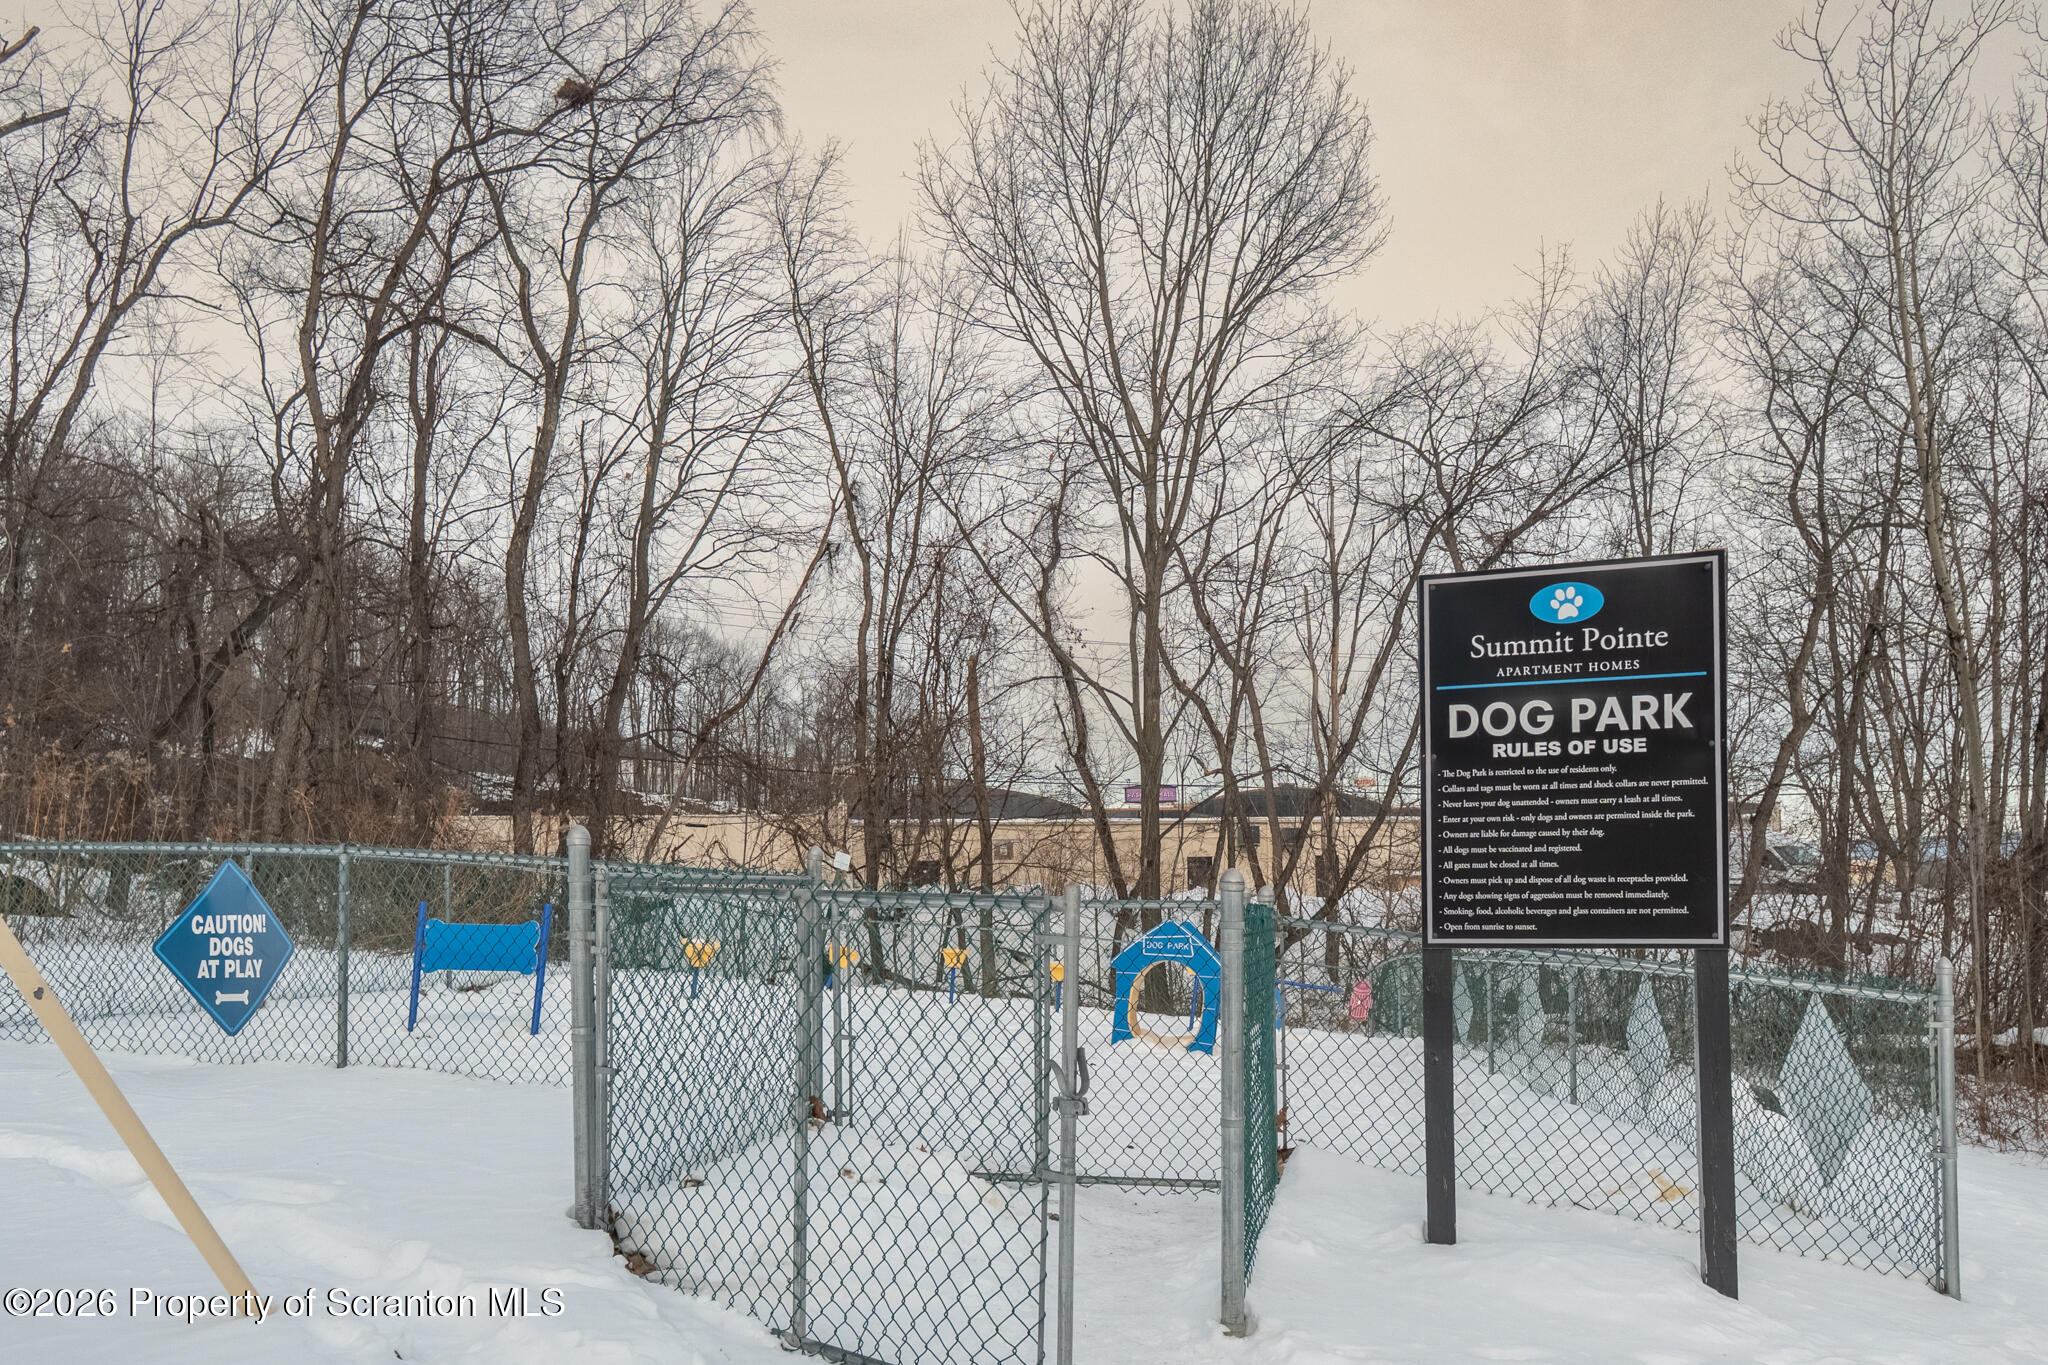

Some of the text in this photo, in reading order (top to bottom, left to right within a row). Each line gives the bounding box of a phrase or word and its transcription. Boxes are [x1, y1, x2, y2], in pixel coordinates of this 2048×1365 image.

[1470, 626, 1669, 659] Summit Pointe
[1496, 659, 1640, 678] APARTMENT HOMES
[1448, 692, 1694, 739] DOG PARK
[1492, 737, 1647, 758] RULES OF USE
[1441, 769, 1455, 777] The
[1456, 769, 1471, 779] Dog
[1472, 768, 1487, 776] Park
[1488, 768, 1494, 776] is
[1494, 766, 1525, 775] restricted
[1535, 766, 1547, 774] the
[1560, 764, 1569, 773] of
[1569, 764, 1599, 773] residents
[1599, 763, 1617, 774] only.
[1441, 784, 1465, 793] Collars
[1466, 783, 1479, 792] and
[1480, 785, 1494, 793] tags
[1512, 782, 1521, 791] be
[1549, 780, 1558, 789] all
[1559, 781, 1578, 789] times
[1578, 779, 1592, 789] and
[1593, 779, 1614, 788] shock
[1614, 778, 1637, 787] collars
[1671, 775, 1708, 788] permitted.
[1442, 799, 1462, 808] Never
[1462, 799, 1479, 807] leave
[1480, 800, 1496, 809] your
[1496, 798, 1510, 808] dog
[1511, 796, 1549, 806] unattended
[1598, 797, 1617, 805] carry
[1623, 794, 1641, 803] leash
[1650, 793, 1660, 802] all
[1661, 793, 1683, 802] times.
[1442, 815, 1461, 823] Enter
[1469, 816, 1485, 824] your
[1502, 813, 1515, 821] risk
[1520, 812, 1536, 823] only
[1536, 812, 1553, 823] dogs
[1554, 811, 1567, 820] and
[1605, 810, 1640, 821] permitted
[1641, 809, 1662, 818] inside
[1663, 809, 1675, 818] the
[1676, 808, 1695, 820] park.
[1442, 830, 1468, 838] Owners
[1480, 829, 1498, 837] liable
[1499, 828, 1510, 837] for
[1510, 828, 1537, 839] damage
[1537, 827, 1560, 836] caused
[1561, 827, 1570, 838] by
[1571, 827, 1588, 836] their
[1589, 827, 1605, 837] dog.
[1442, 845, 1452, 853] All
[1453, 845, 1469, 855] dogs
[1488, 844, 1497, 853] be
[1497, 843, 1532, 852] vaccinated
[1533, 843, 1547, 852] and
[1548, 843, 1582, 854] registered.
[1442, 860, 1453, 869] All
[1453, 862, 1470, 871] gates
[1489, 860, 1498, 868] be
[1498, 859, 1520, 868] closed
[1528, 859, 1537, 868] all
[1442, 876, 1469, 884] Owners
[1487, 875, 1502, 886] pick
[1503, 877, 1513, 886] up
[1514, 875, 1527, 883] and
[1528, 875, 1553, 885] dispose
[1553, 874, 1563, 883] of
[1562, 874, 1571, 883] all
[1572, 874, 1587, 885] dog
[1607, 874, 1615, 882] in
[1616, 873, 1654, 884] receptacles
[1654, 873, 1688, 884] provided.
[1443, 891, 1457, 901] Any
[1457, 891, 1474, 901] dogs
[1474, 891, 1502, 901] showing
[1503, 891, 1520, 901] signs
[1520, 890, 1530, 899] of
[1529, 891, 1564, 901] aggression
[1583, 890, 1593, 898] be
[1594, 889, 1623, 898] removed
[1624, 889, 1669, 900] immediately.
[1443, 906, 1475, 917] Smoking,
[1475, 906, 1493, 915] food,
[1494, 906, 1524, 915] alcoholic
[1525, 906, 1557, 917] beverages
[1558, 905, 1571, 914] and
[1572, 905, 1589, 916] glass
[1589, 906, 1625, 914] containers
[1652, 905, 1689, 916] permitted.
[191, 914, 266, 935] CAUTION!
[1443, 922, 1462, 932] Open
[1463, 921, 1480, 930] from
[1481, 922, 1504, 930] sunrise
[209, 936, 254, 957] DOGS
[1146, 941, 1190, 950] DOG PARK
[197, 959, 263, 979] AT PLAY
